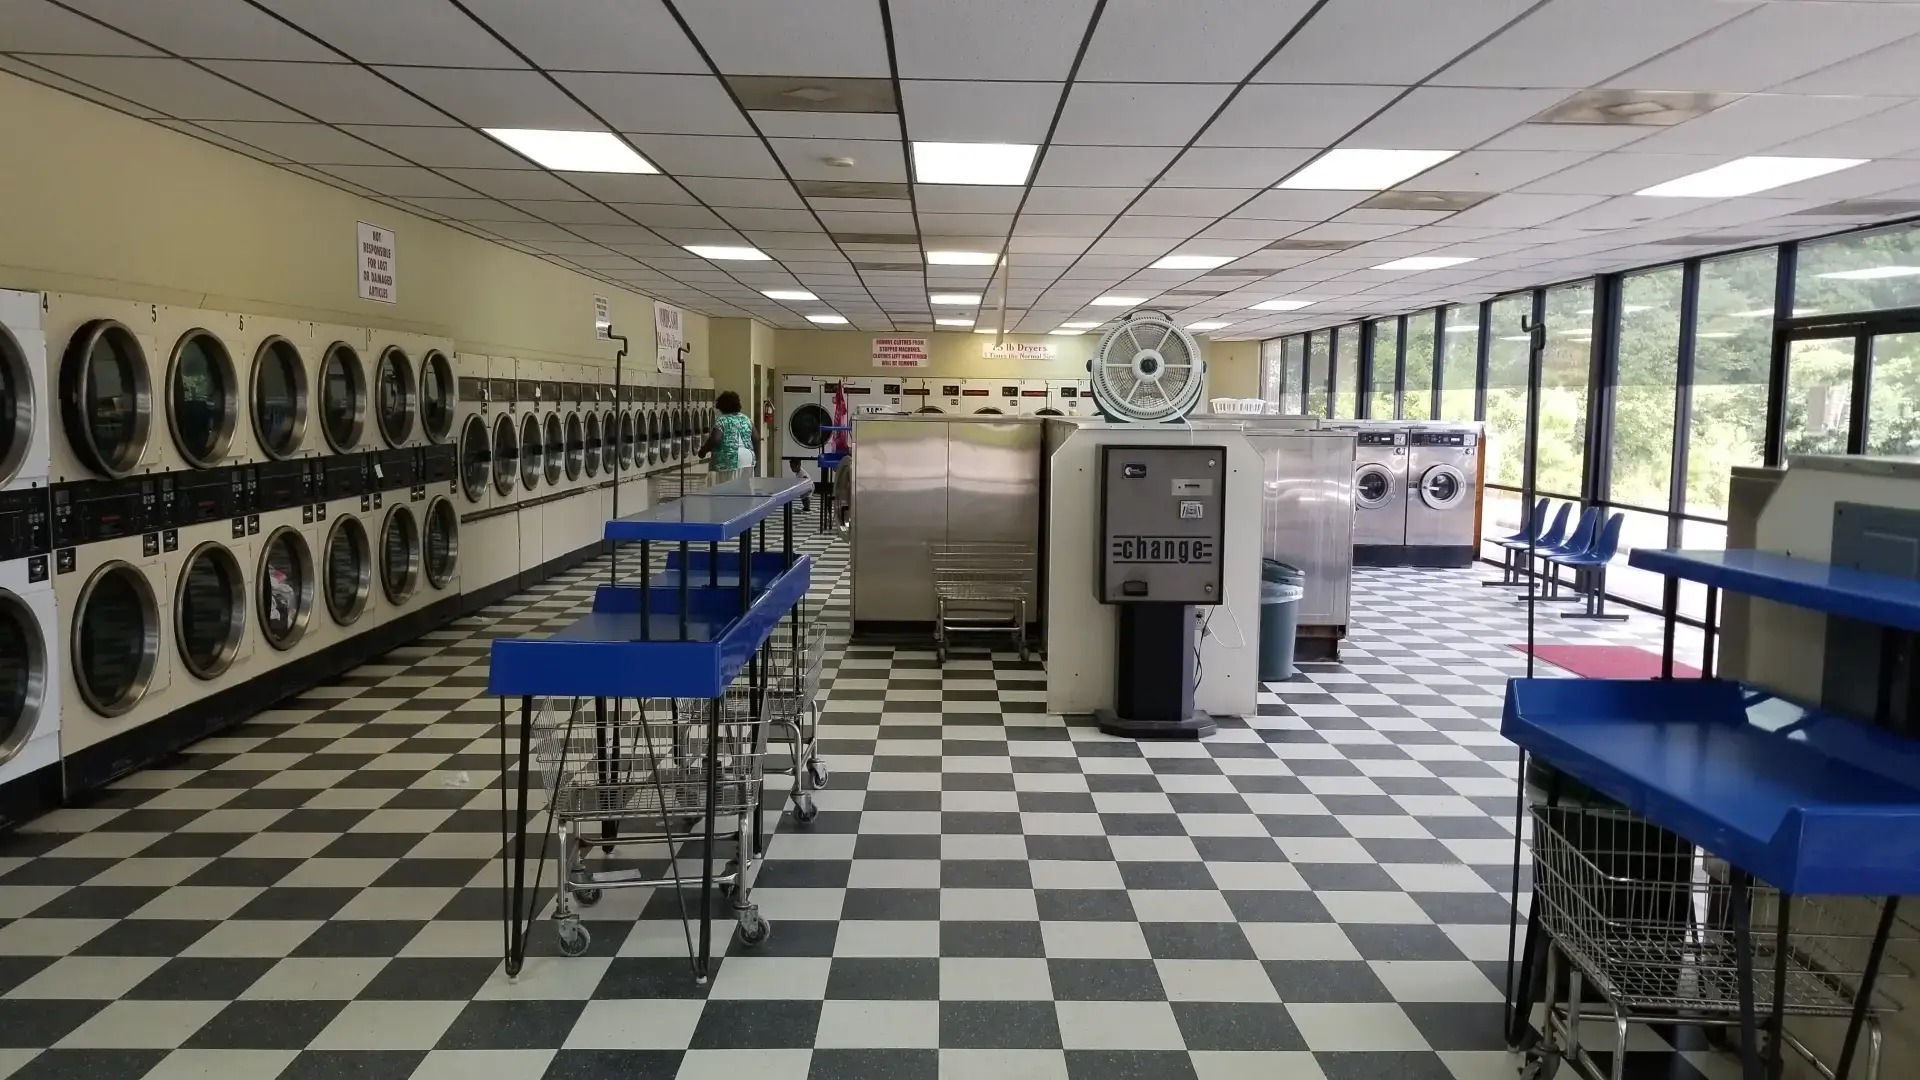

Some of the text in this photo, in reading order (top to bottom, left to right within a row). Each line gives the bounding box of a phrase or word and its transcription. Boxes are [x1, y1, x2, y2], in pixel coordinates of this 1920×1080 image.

[372, 231, 382, 243] NOT
[363, 241, 391, 259] RESPONSIBLE
[367, 257, 388, 272] FOR LOST
[363, 270, 392, 286] OR DAMAGED
[368, 286, 388, 299] ARTICLES
[42, 292, 49, 314] 4
[151, 304, 157, 323] 5
[238, 315, 244, 331] 6
[309, 323, 314, 339] 7
[1006, 343, 1015, 351] lb
[1017, 343, 1047, 352] Dryers
[1122, 535, 1203, 564] change
